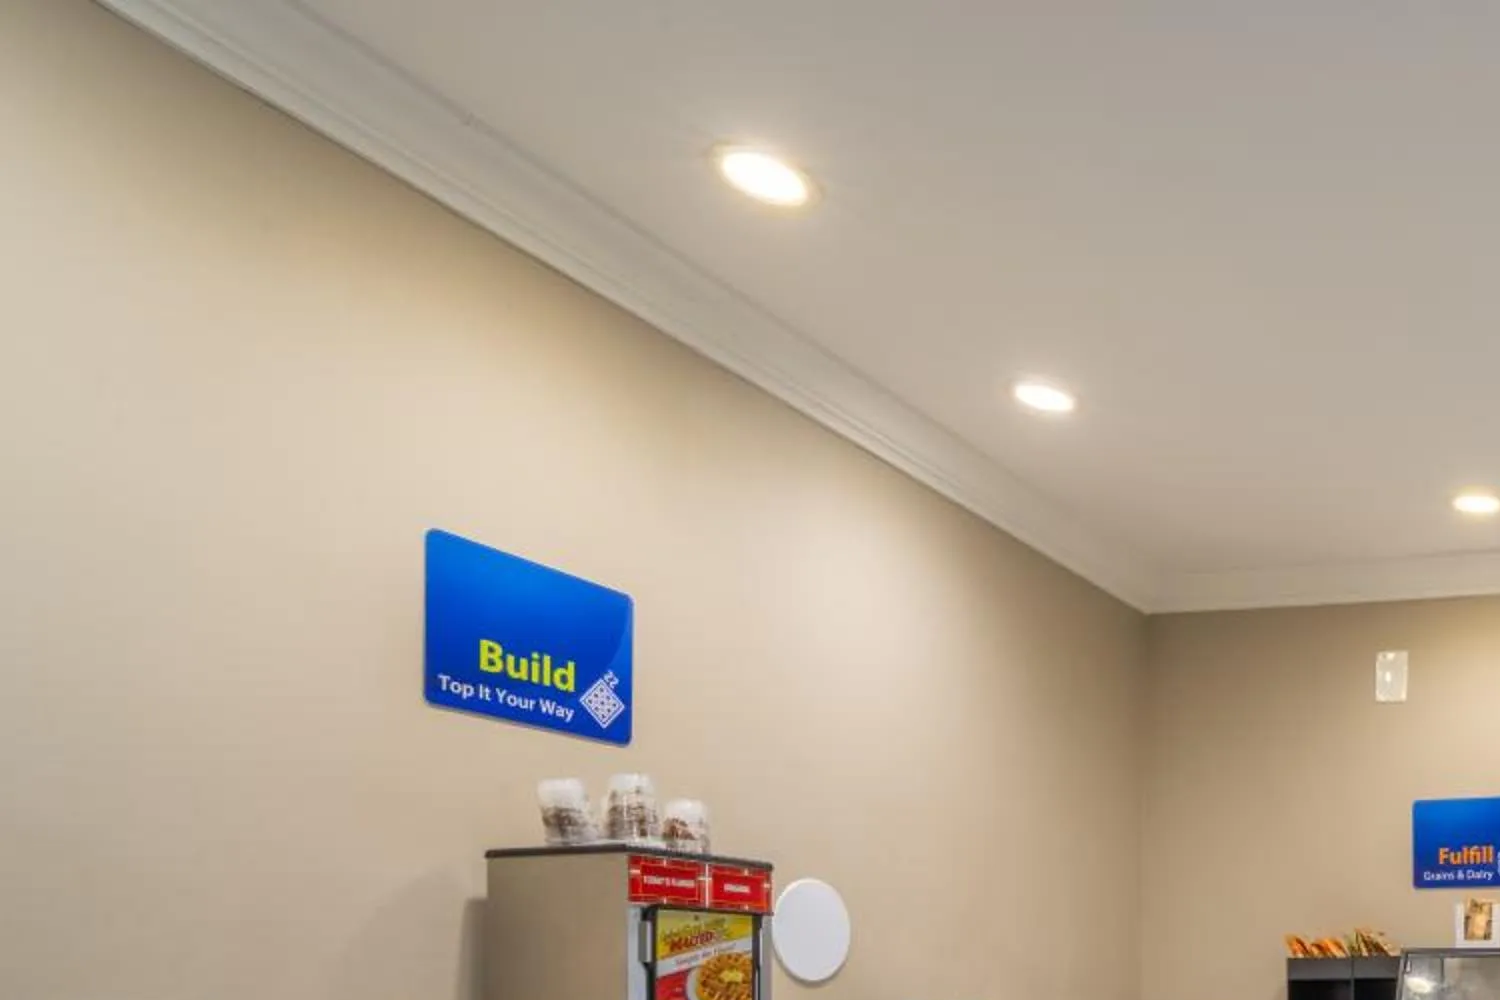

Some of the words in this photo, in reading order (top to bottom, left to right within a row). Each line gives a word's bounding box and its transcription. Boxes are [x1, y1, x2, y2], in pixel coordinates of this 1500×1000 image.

[479, 638, 576, 692] Build
[438, 673, 474, 698] Top
[479, 682, 492, 701] It
[495, 687, 536, 711] Your
[540, 697, 575, 722] Way
[1438, 845, 1494, 865] Fulfill
[1423, 870, 1455, 881] Grains
[1466, 869, 1494, 881] Dairy
